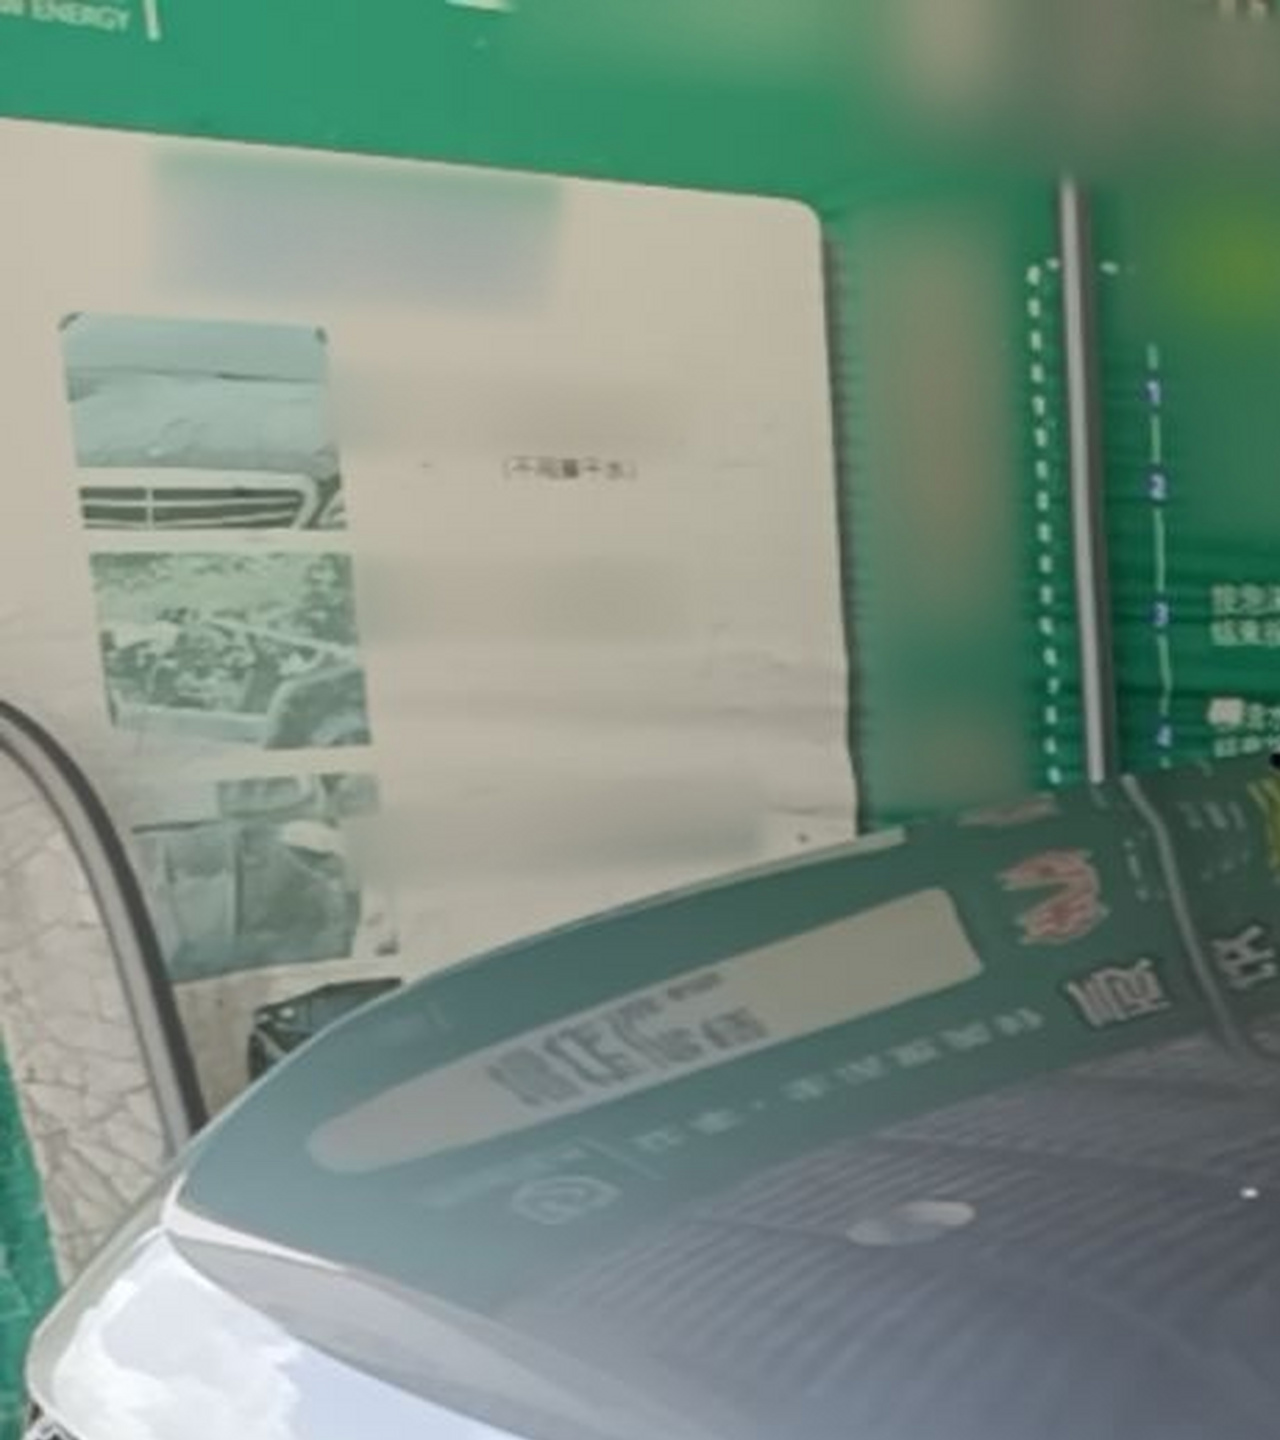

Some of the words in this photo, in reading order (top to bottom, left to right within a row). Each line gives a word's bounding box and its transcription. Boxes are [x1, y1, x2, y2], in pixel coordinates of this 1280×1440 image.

[31, 0, 130, 33] ENERGY
[1150, 473, 1166, 500] 2
[1154, 602, 1169, 628] 3
